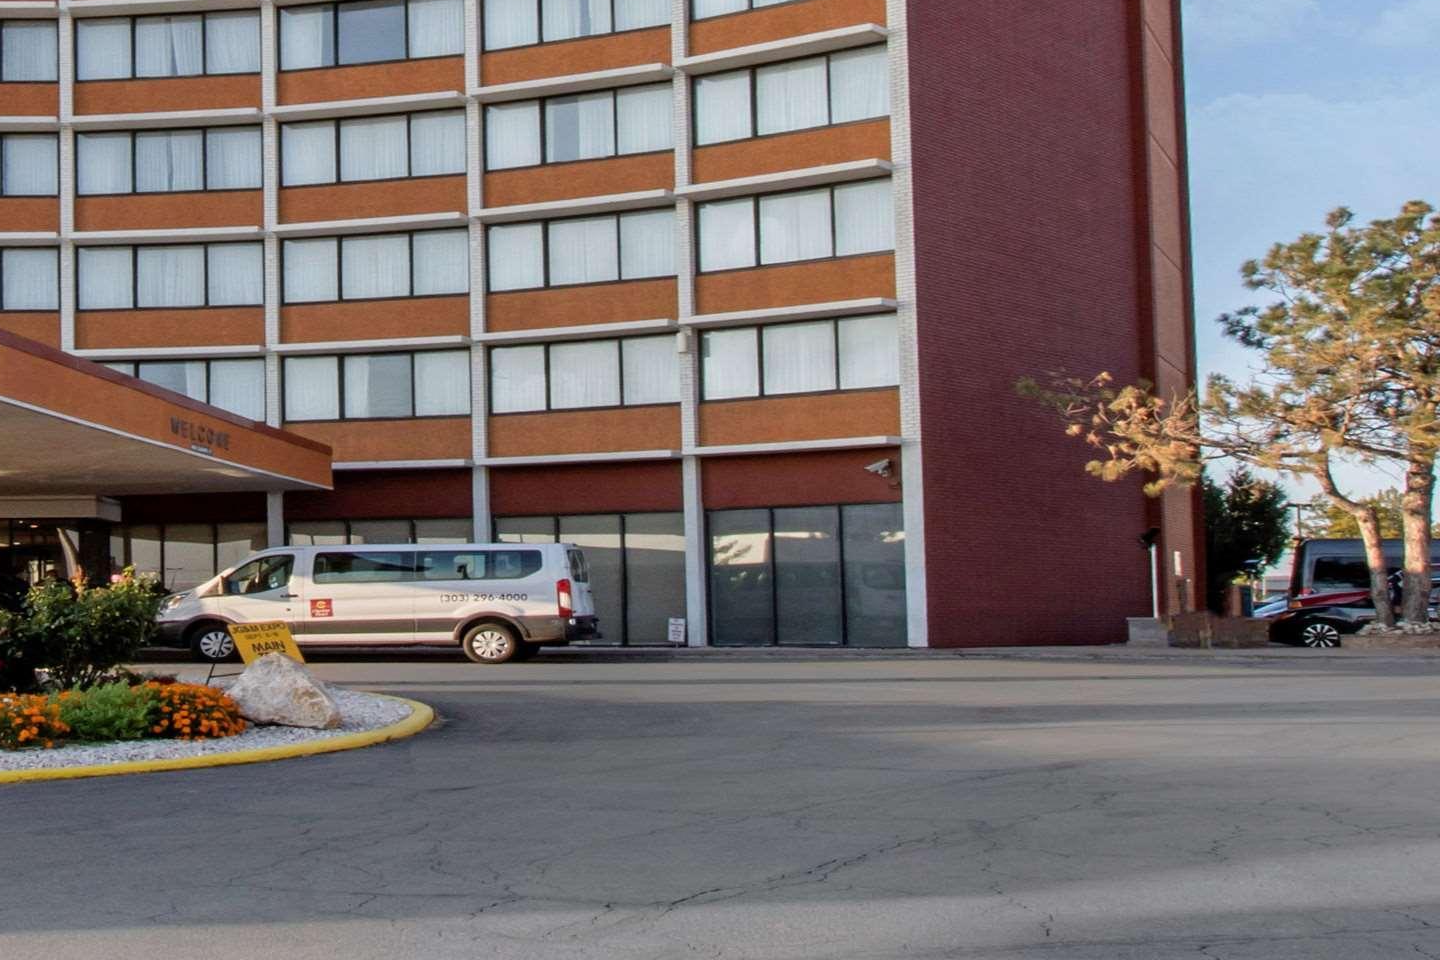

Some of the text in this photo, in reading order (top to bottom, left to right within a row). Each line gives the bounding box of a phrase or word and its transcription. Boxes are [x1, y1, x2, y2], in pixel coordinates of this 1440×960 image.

[169, 415, 231, 451] WELCOME
[439, 592, 529, 603] (303) 296-4000
[251, 640, 286, 652] MAIN
